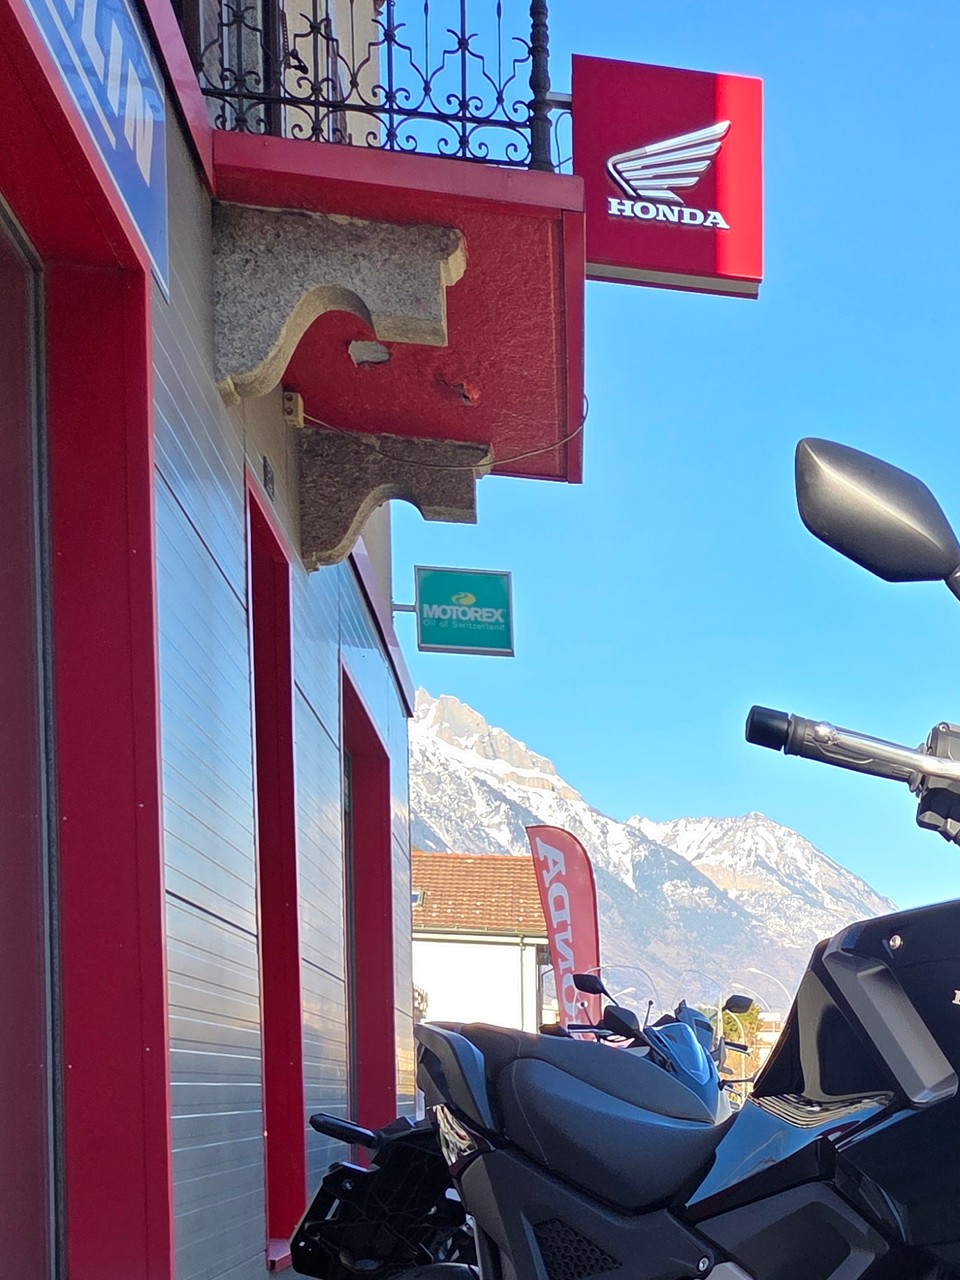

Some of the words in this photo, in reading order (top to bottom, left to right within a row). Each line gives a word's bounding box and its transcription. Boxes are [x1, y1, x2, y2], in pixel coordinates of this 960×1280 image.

[608, 198, 730, 229] HONDA
[423, 604, 504, 623] MOTOREX
[423, 619, 436, 627] Oil
[452, 621, 505, 631] Switzerland
